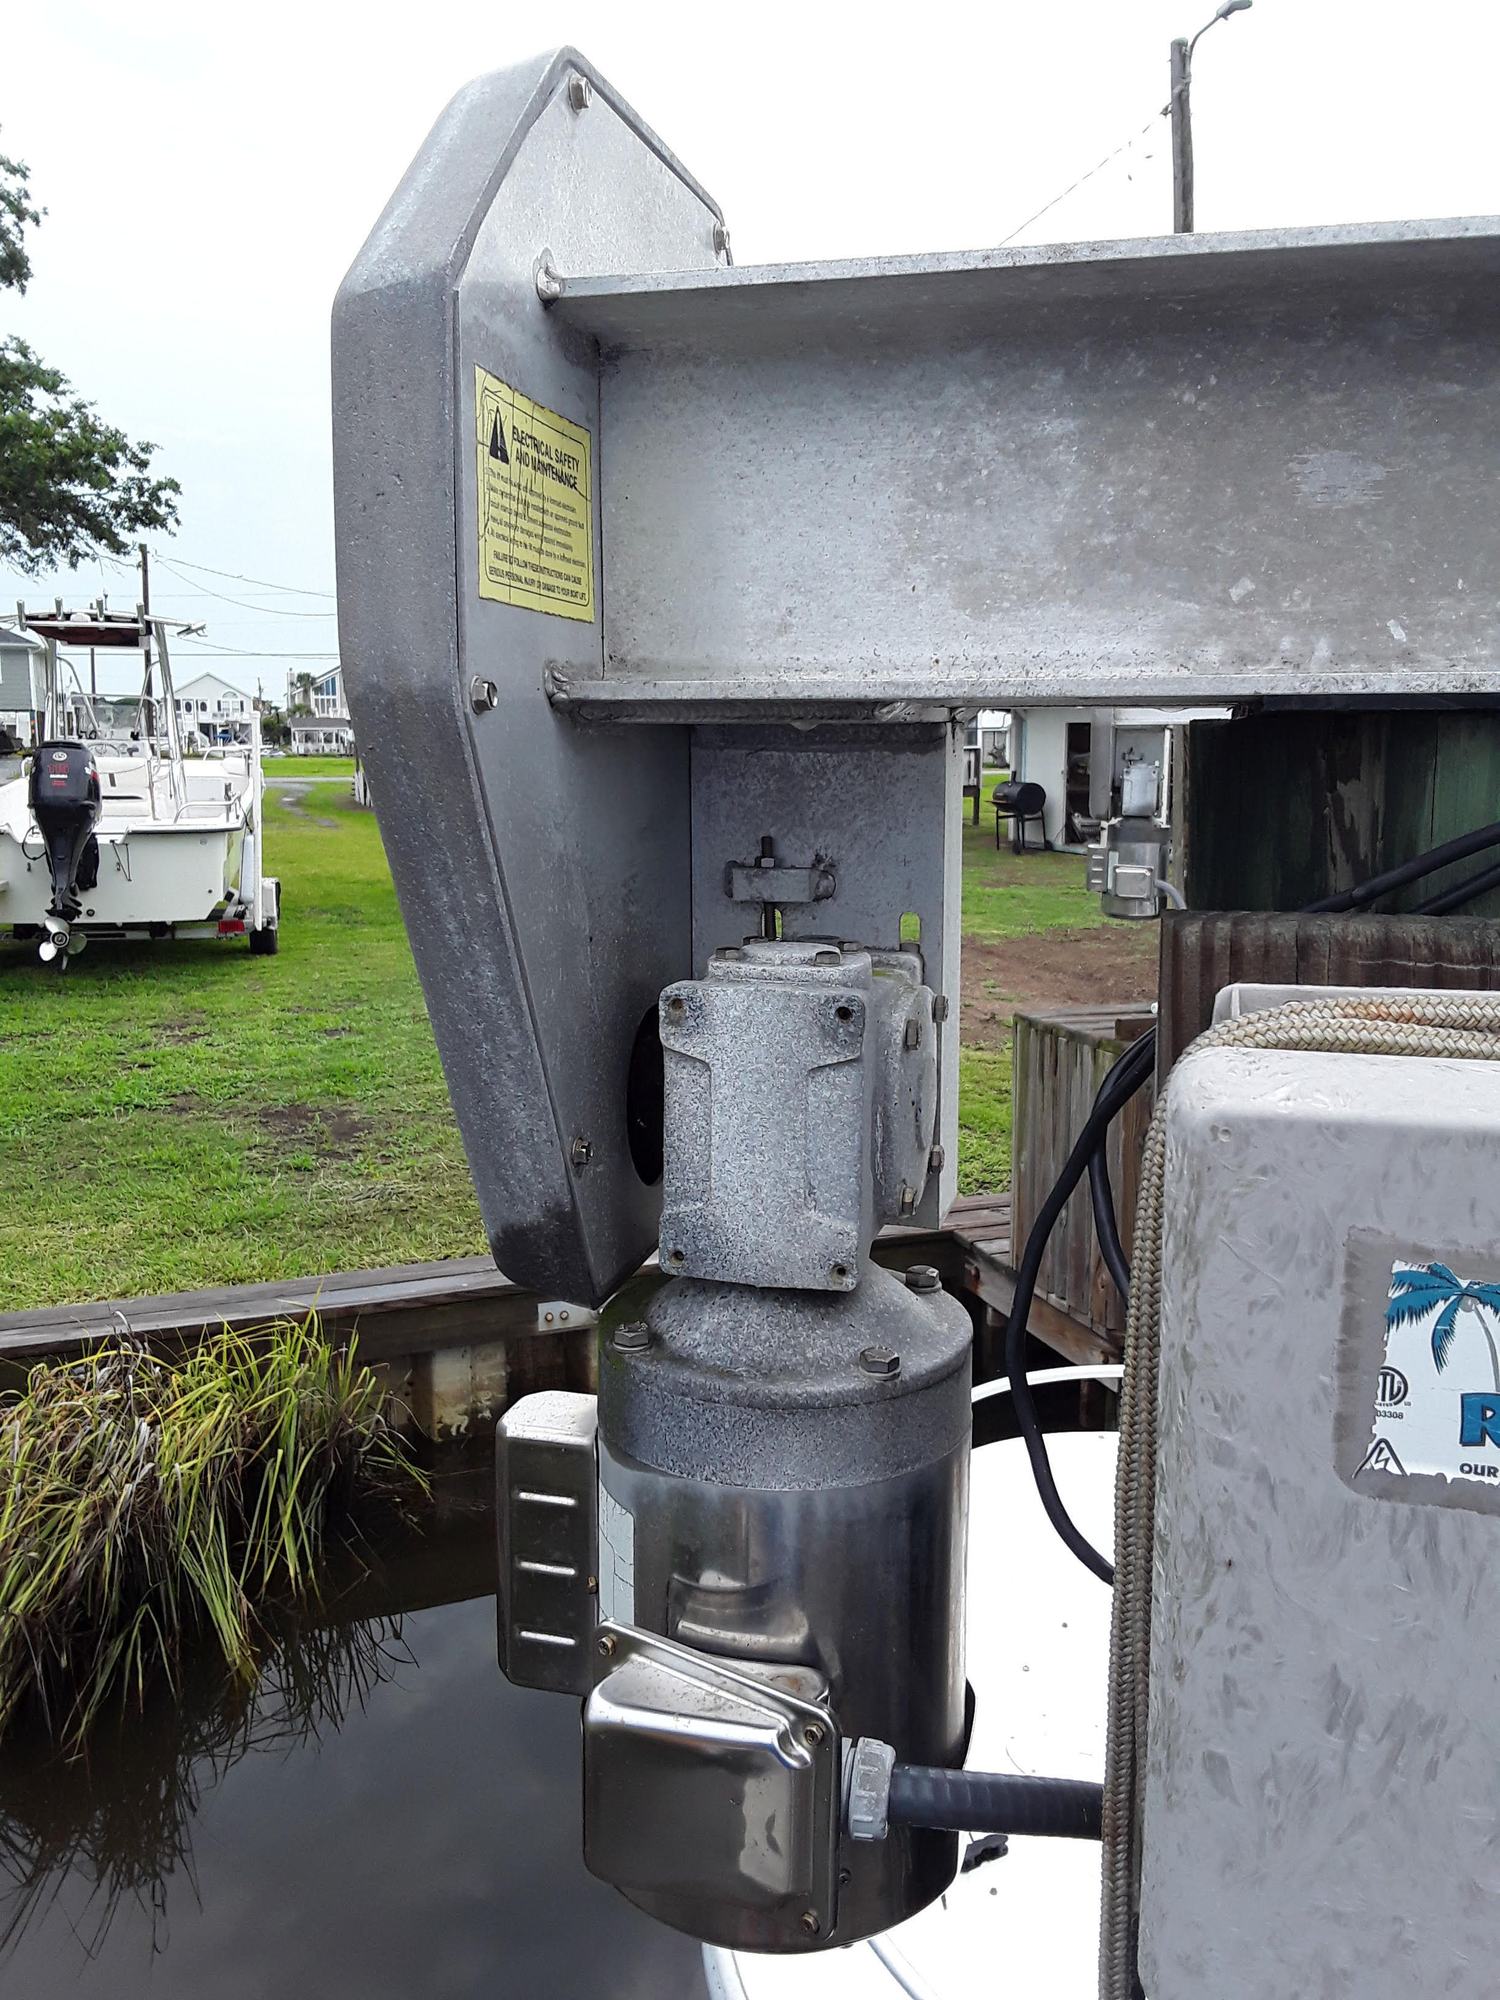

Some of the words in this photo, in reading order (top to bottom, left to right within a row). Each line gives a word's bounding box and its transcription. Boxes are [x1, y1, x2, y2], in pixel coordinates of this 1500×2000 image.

[512, 425, 553, 460] ELECTRICAL
[555, 448, 580, 473] SAFETY
[516, 447, 530, 468] AND
[531, 455, 578, 490] MAINTENANCE
[1459, 1462, 1500, 1478] OUR
